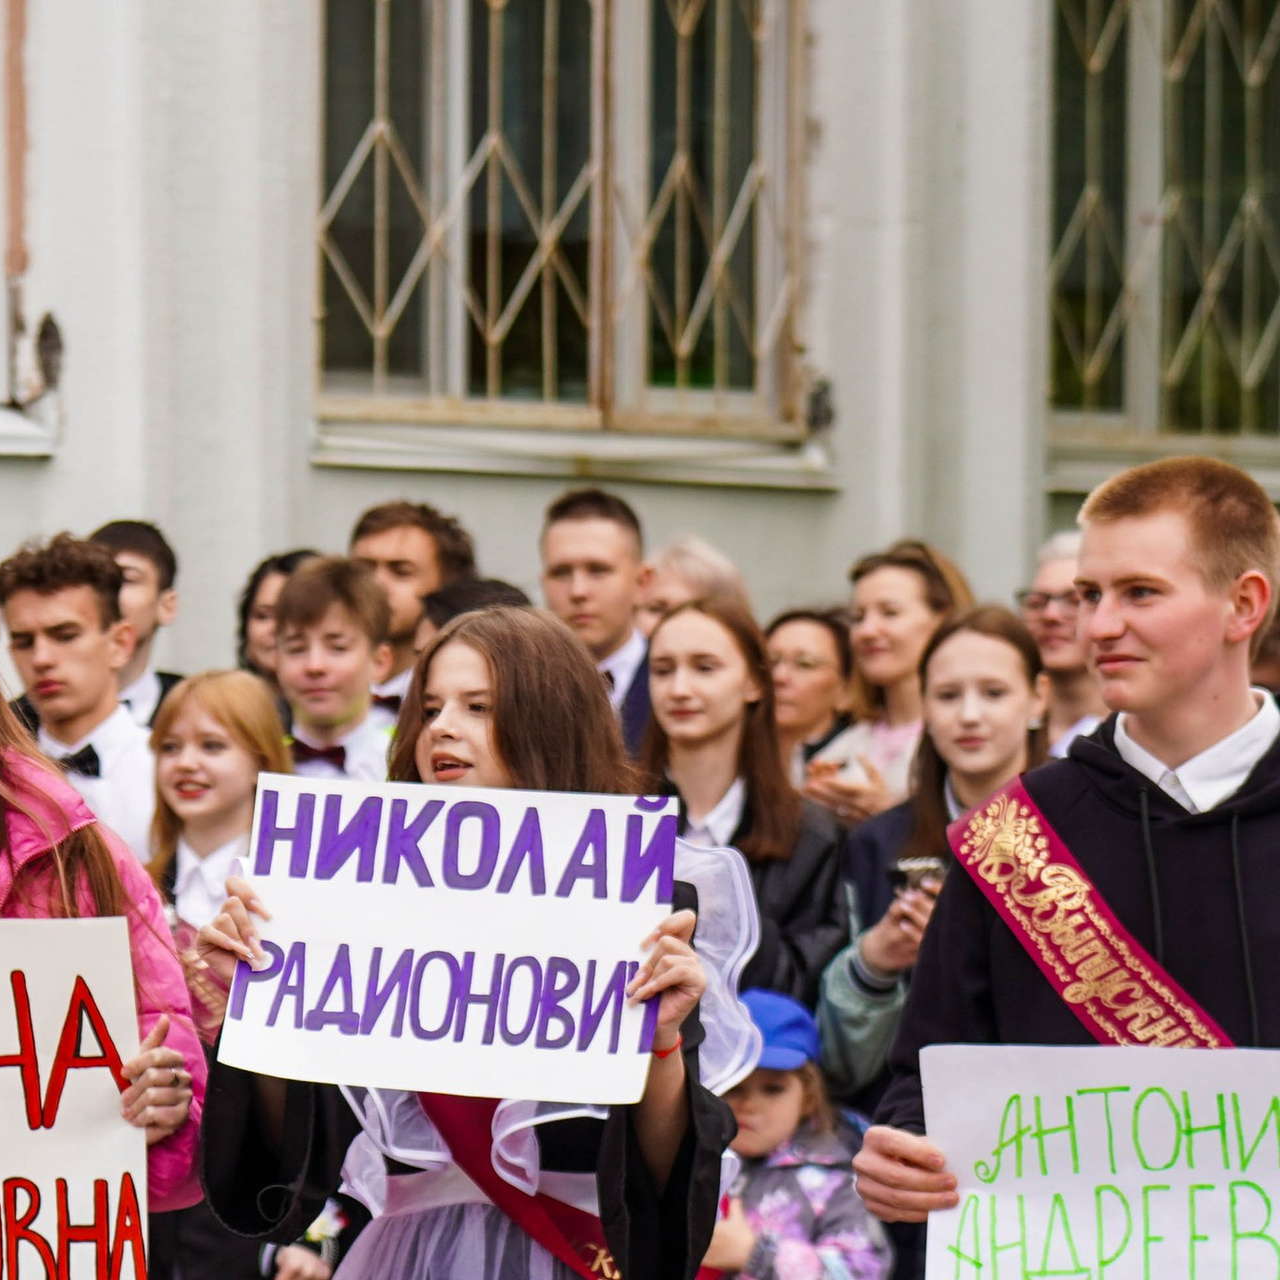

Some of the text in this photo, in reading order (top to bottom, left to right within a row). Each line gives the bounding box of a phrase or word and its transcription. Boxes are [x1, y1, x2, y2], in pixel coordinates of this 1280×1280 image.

[253, 789, 677, 905] НИКОЛАЙ
[1010, 863, 1197, 1047] Выпускн
[974, 1086, 1280, 1184] АНТОНИ
